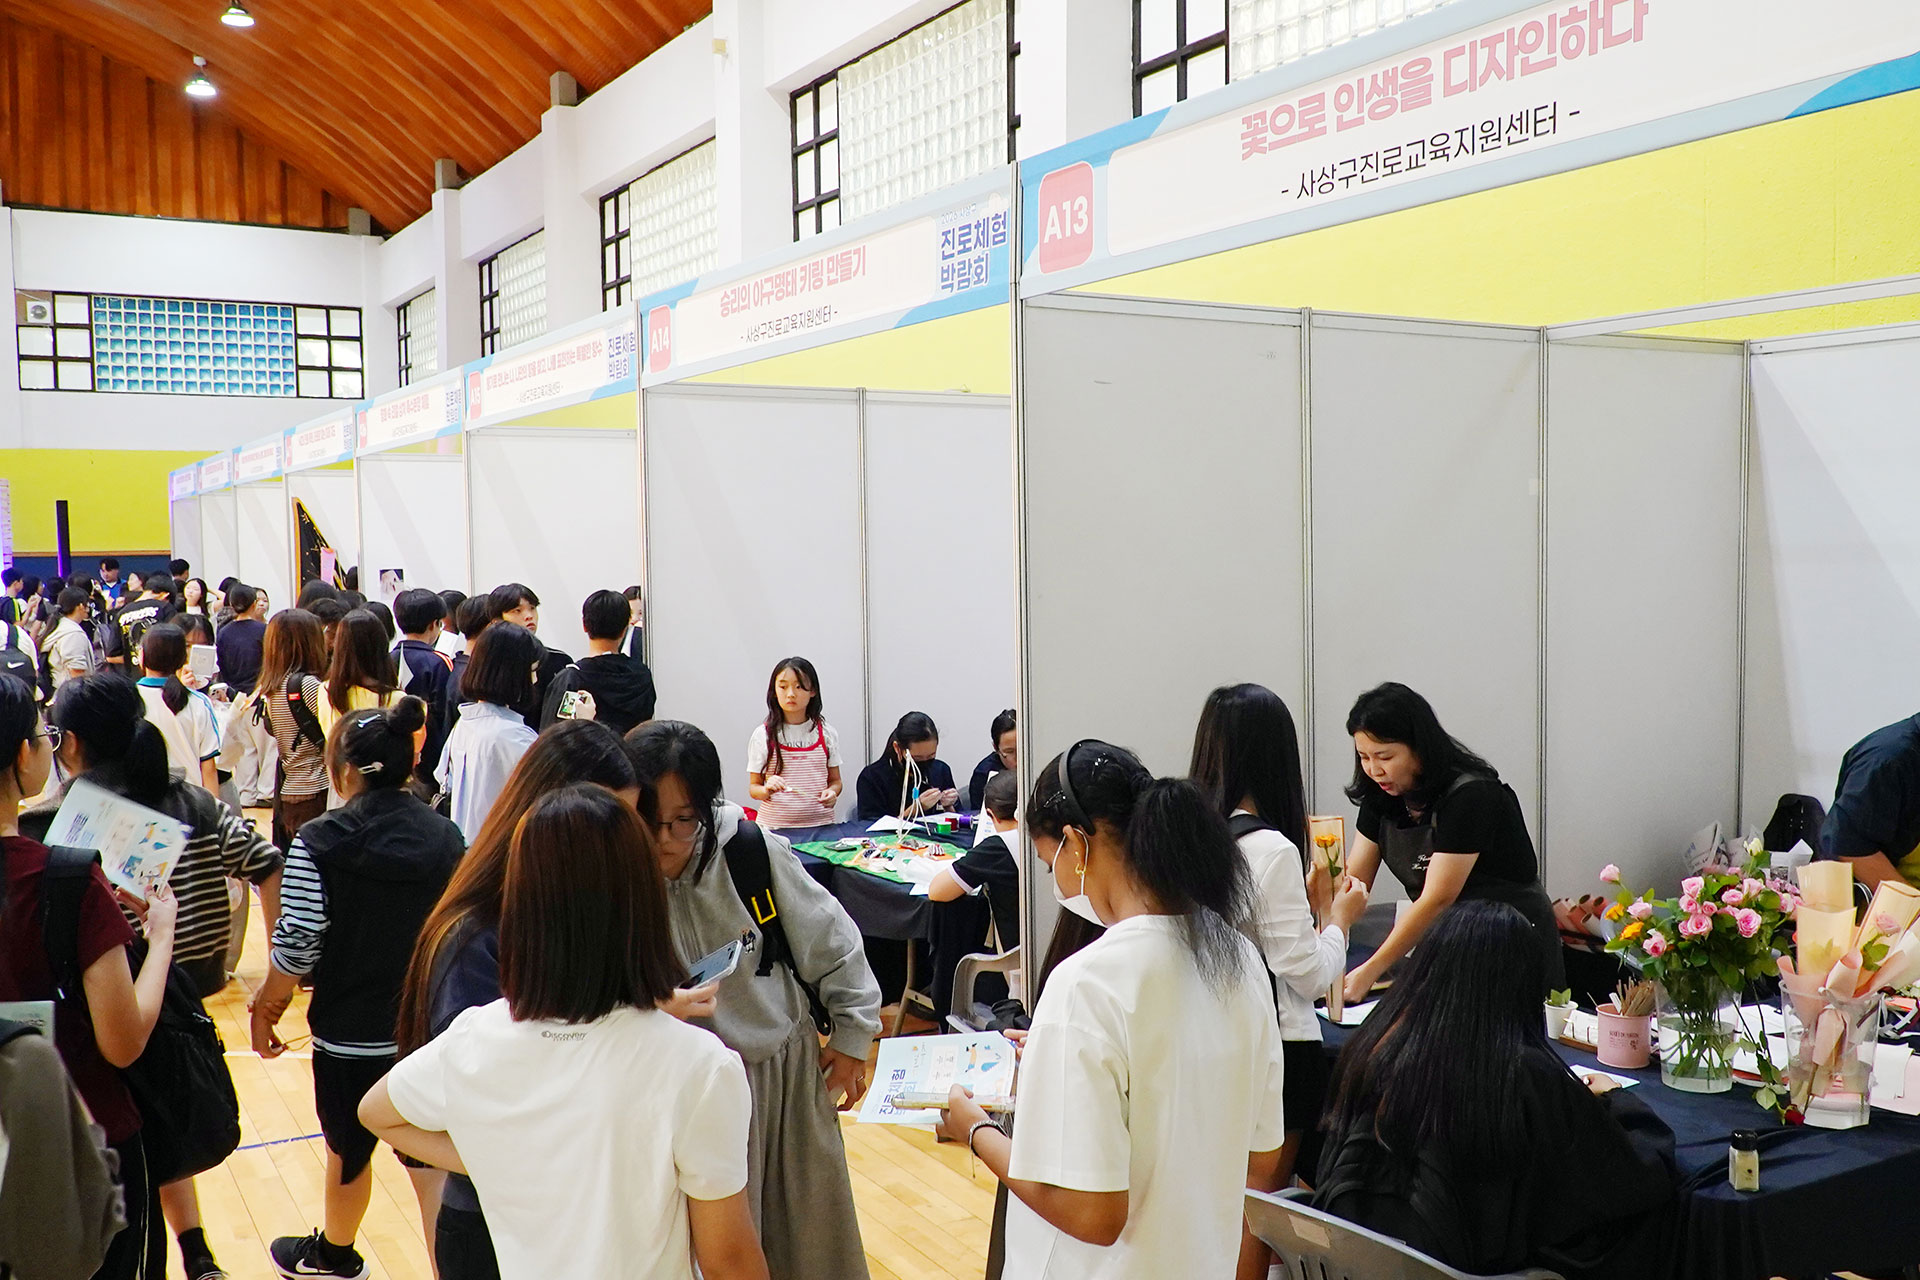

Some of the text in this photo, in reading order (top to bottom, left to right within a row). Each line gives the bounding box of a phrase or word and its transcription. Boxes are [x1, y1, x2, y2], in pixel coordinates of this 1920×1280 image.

[1241, 0, 1649, 160] 꽃으로 인생을 디자인하다
[1296, 100, 1559, 200] 사상구진로교육지원센터
[941, 210, 1007, 261] 진로체험
[1042, 193, 1090, 243] A13
[720, 283, 750, 318] 승리의
[800, 258, 823, 294] 키링
[827, 245, 866, 287] 만들기
[941, 252, 989, 294] 박람회
[608, 331, 636, 359] 진로체험
[651, 325, 670, 355] A14
[745, 304, 832, 344] 사상구진로교육지원센터
[542, 1030, 588, 1041] Discovery
